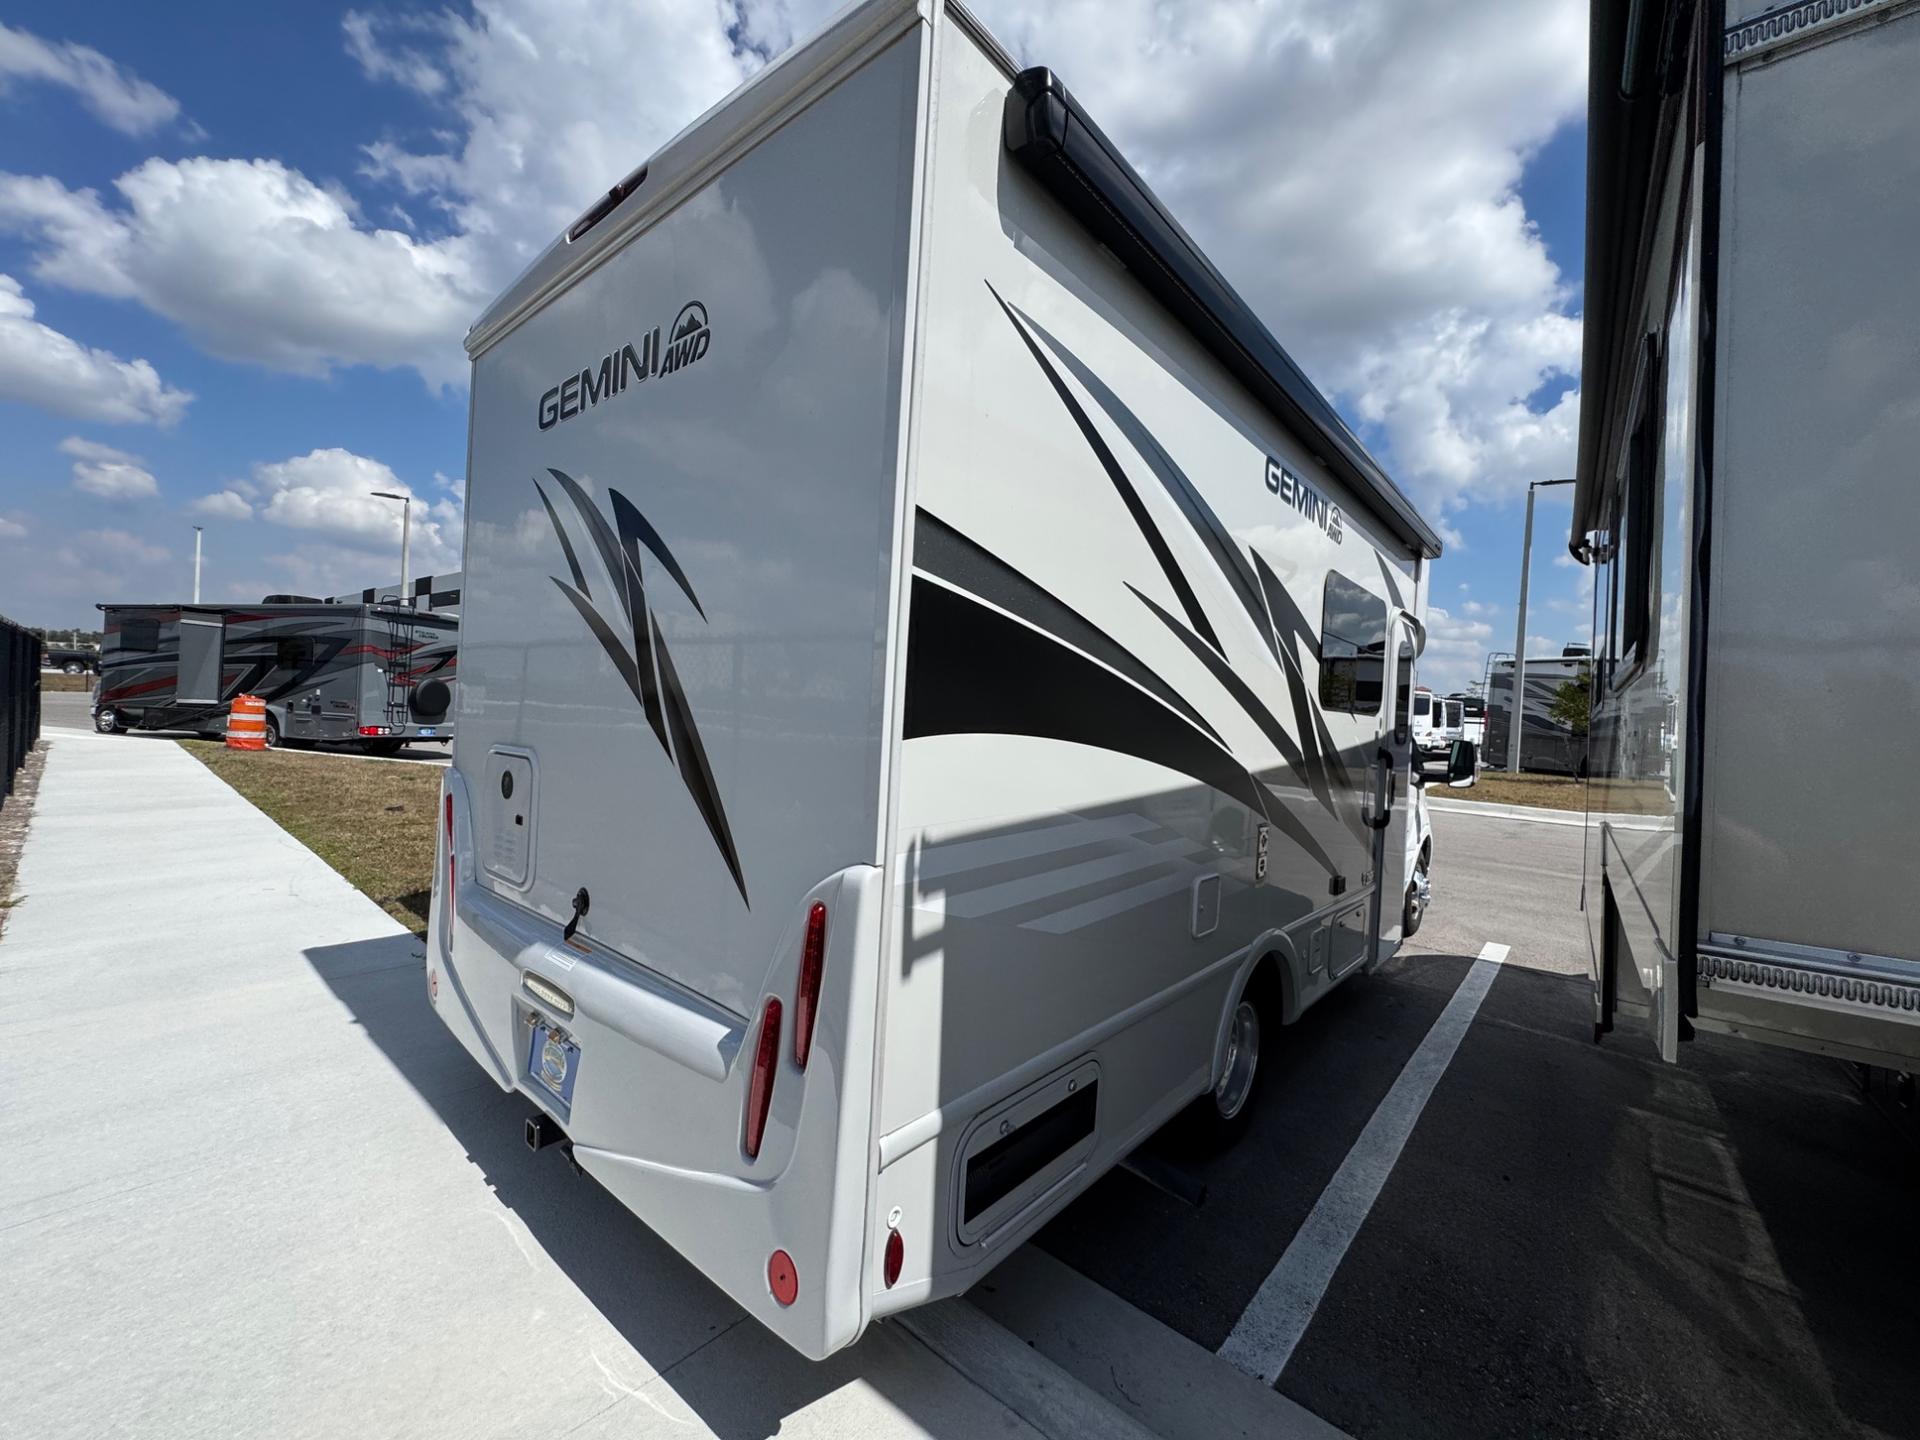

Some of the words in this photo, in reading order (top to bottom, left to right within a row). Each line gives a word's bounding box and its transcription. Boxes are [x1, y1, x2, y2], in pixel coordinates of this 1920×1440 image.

[539, 325, 660, 431] GEMINI
[659, 327, 711, 379] AWD
[1265, 455, 1328, 532] GEMINI
[1326, 523, 1343, 546] AWD
